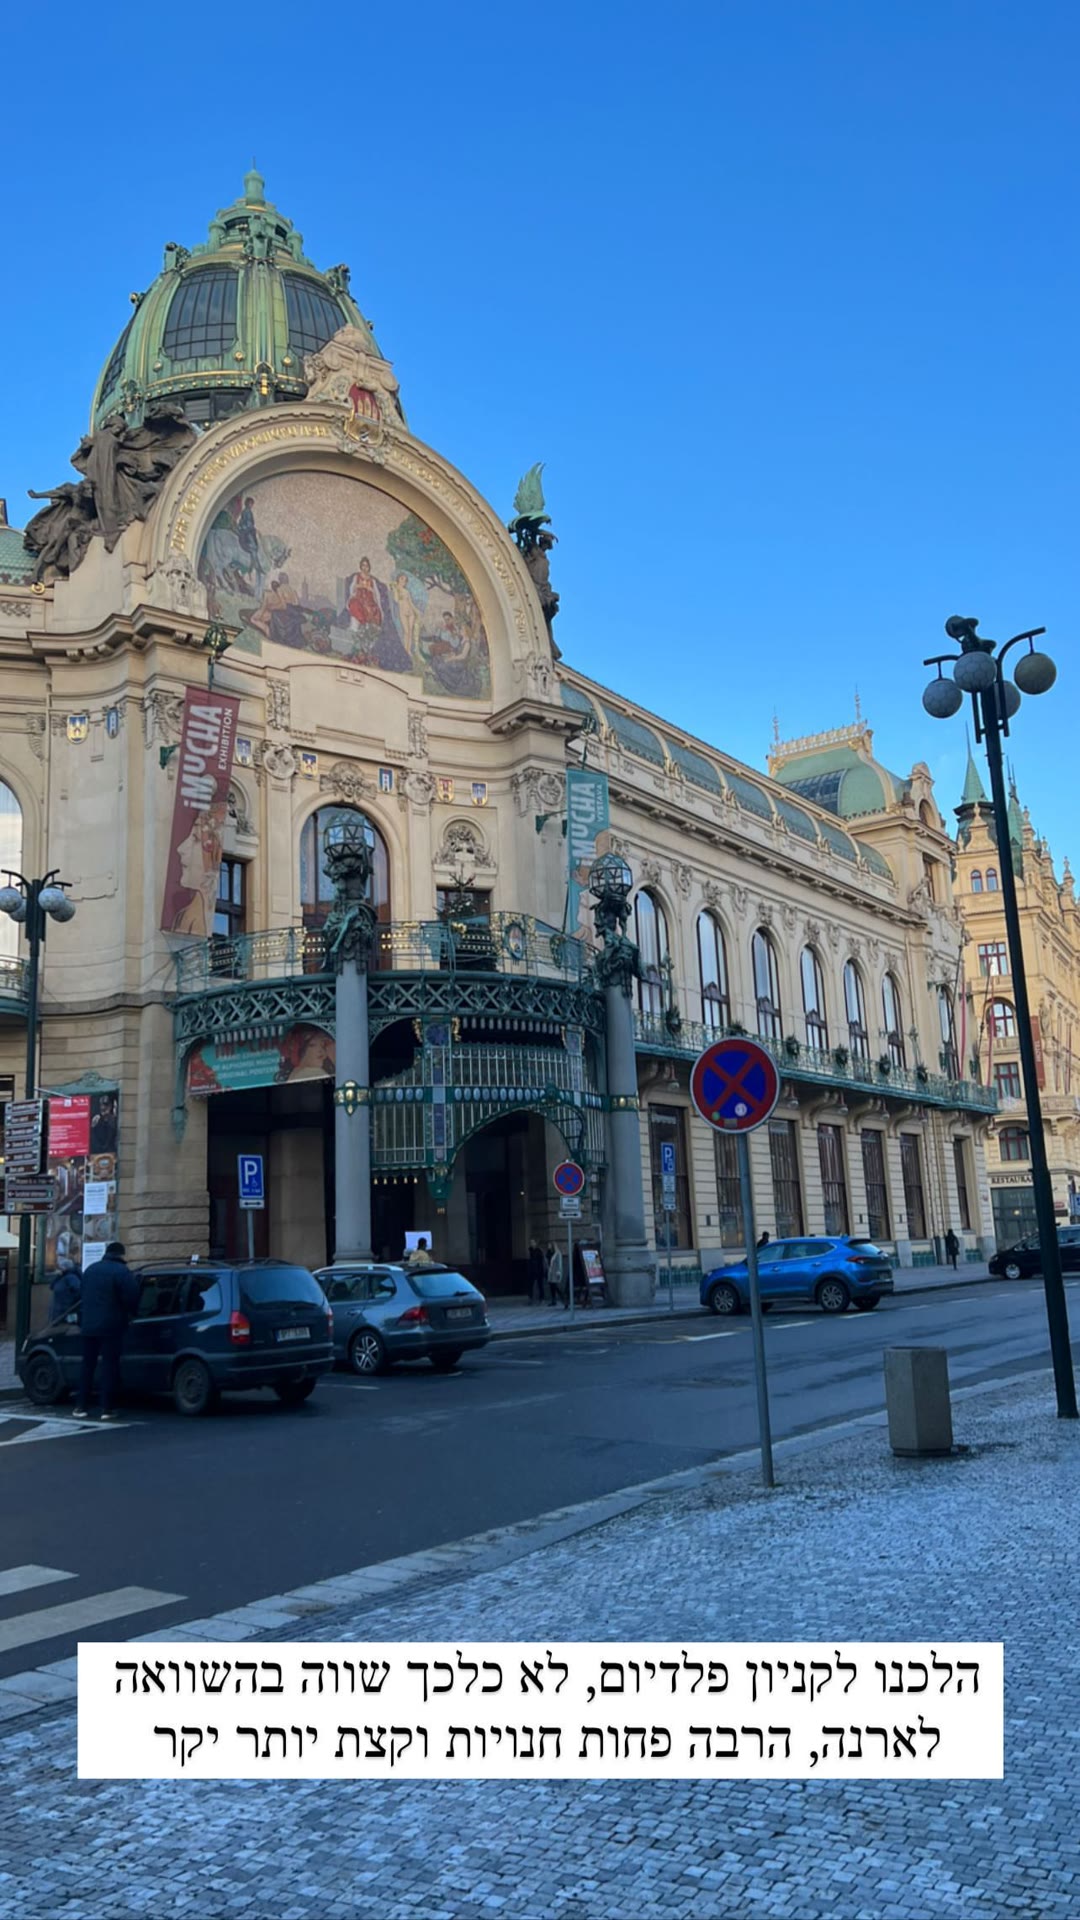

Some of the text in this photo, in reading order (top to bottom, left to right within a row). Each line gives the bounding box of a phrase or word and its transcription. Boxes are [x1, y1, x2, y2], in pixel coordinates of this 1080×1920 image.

[218, 708, 233, 770] EXHIBITION
[665, 1146, 673, 1163] P
[244, 1160, 258, 1185] P
[991, 1175, 1033, 1185] RESTAURA
